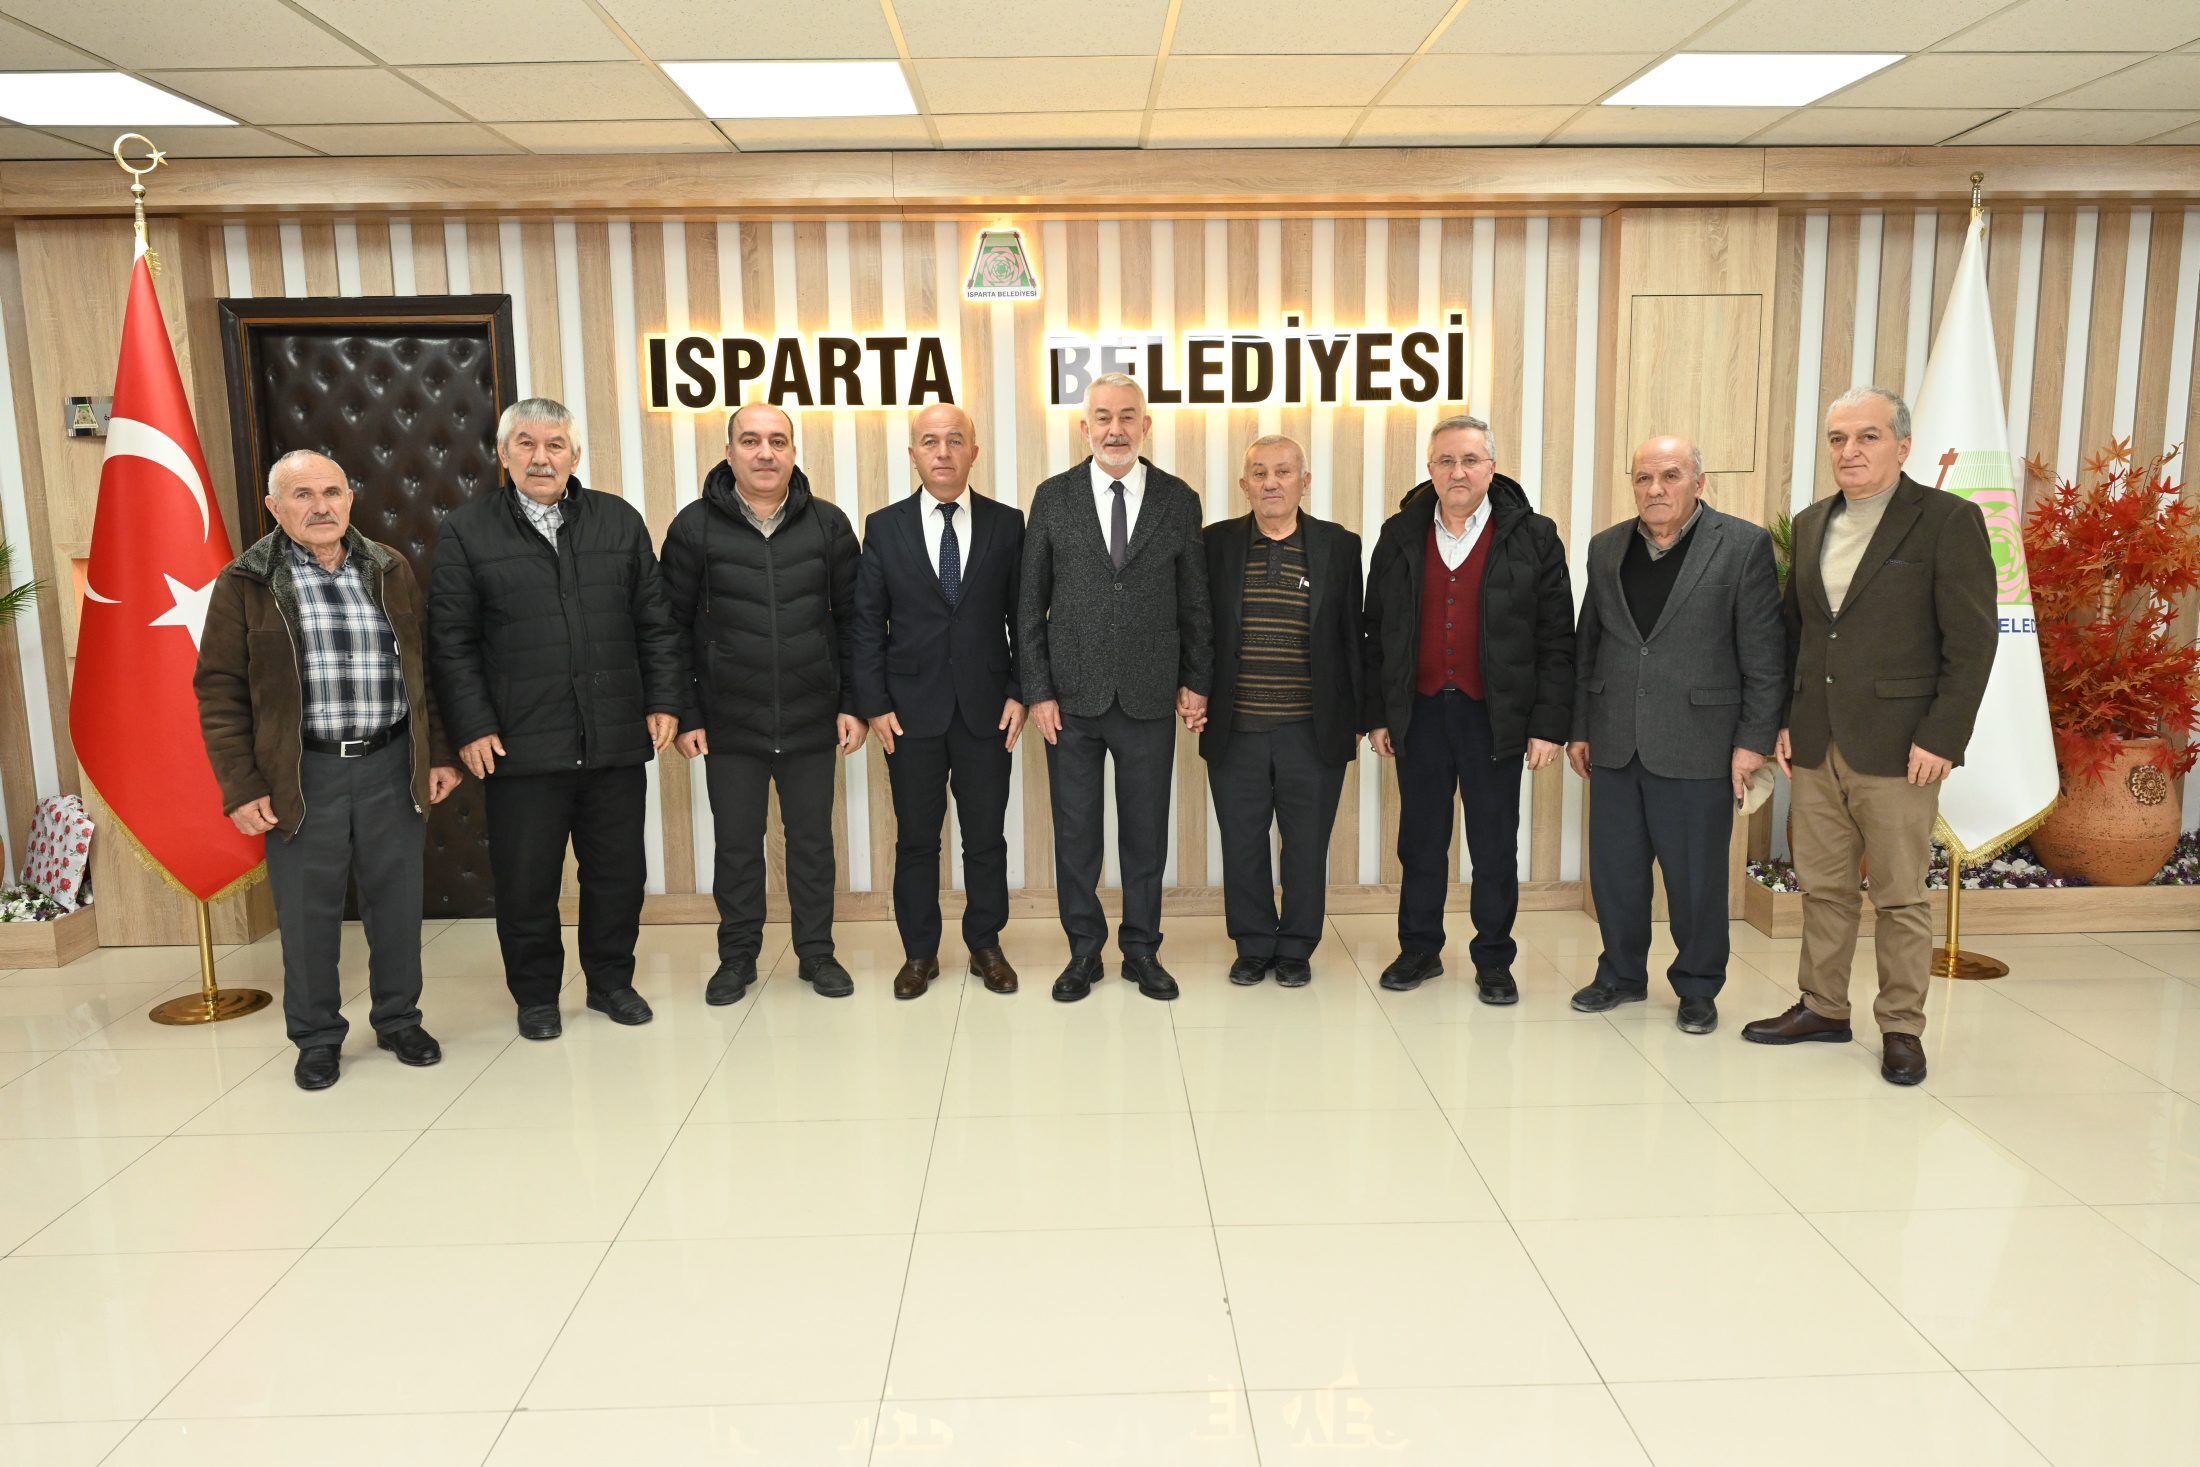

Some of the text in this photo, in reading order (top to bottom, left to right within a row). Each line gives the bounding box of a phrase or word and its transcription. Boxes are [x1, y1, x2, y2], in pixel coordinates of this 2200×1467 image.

[649, 314, 1464, 408] ISPARTA BELEDİYESİ
[1998, 618, 2037, 633] ELED
